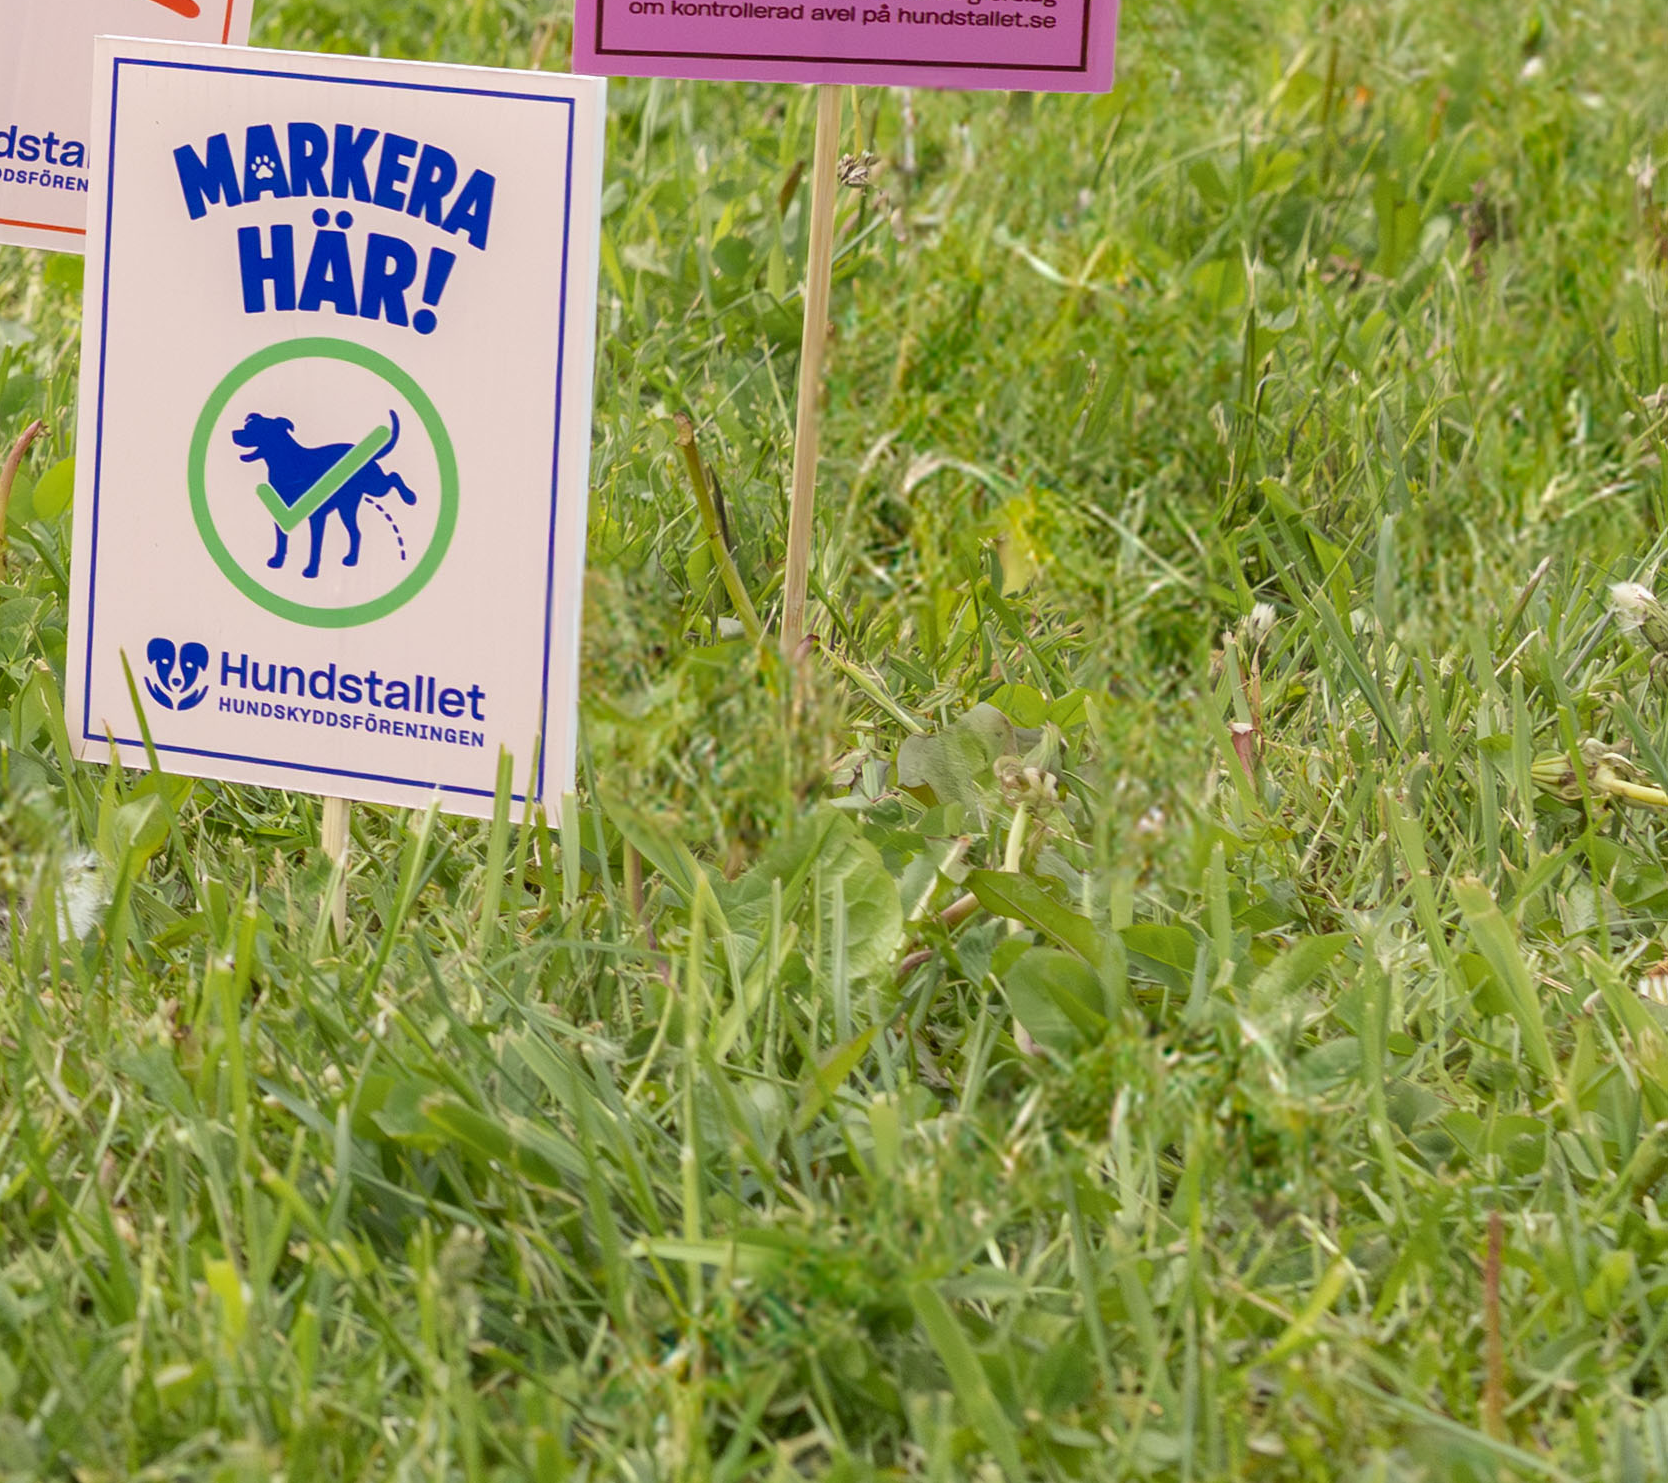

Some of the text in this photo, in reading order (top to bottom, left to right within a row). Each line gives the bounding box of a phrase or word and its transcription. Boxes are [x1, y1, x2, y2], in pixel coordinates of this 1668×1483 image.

[629, 0, 1056, 28] om kontrollerad avel på hundstallet.se
[173, 123, 495, 250] MARKERA
[238, 208, 456, 334] HÄR!
[221, 652, 485, 721] Hundstallet
[219, 697, 484, 747] HUNDSKYDDSFÖRENINGEN
